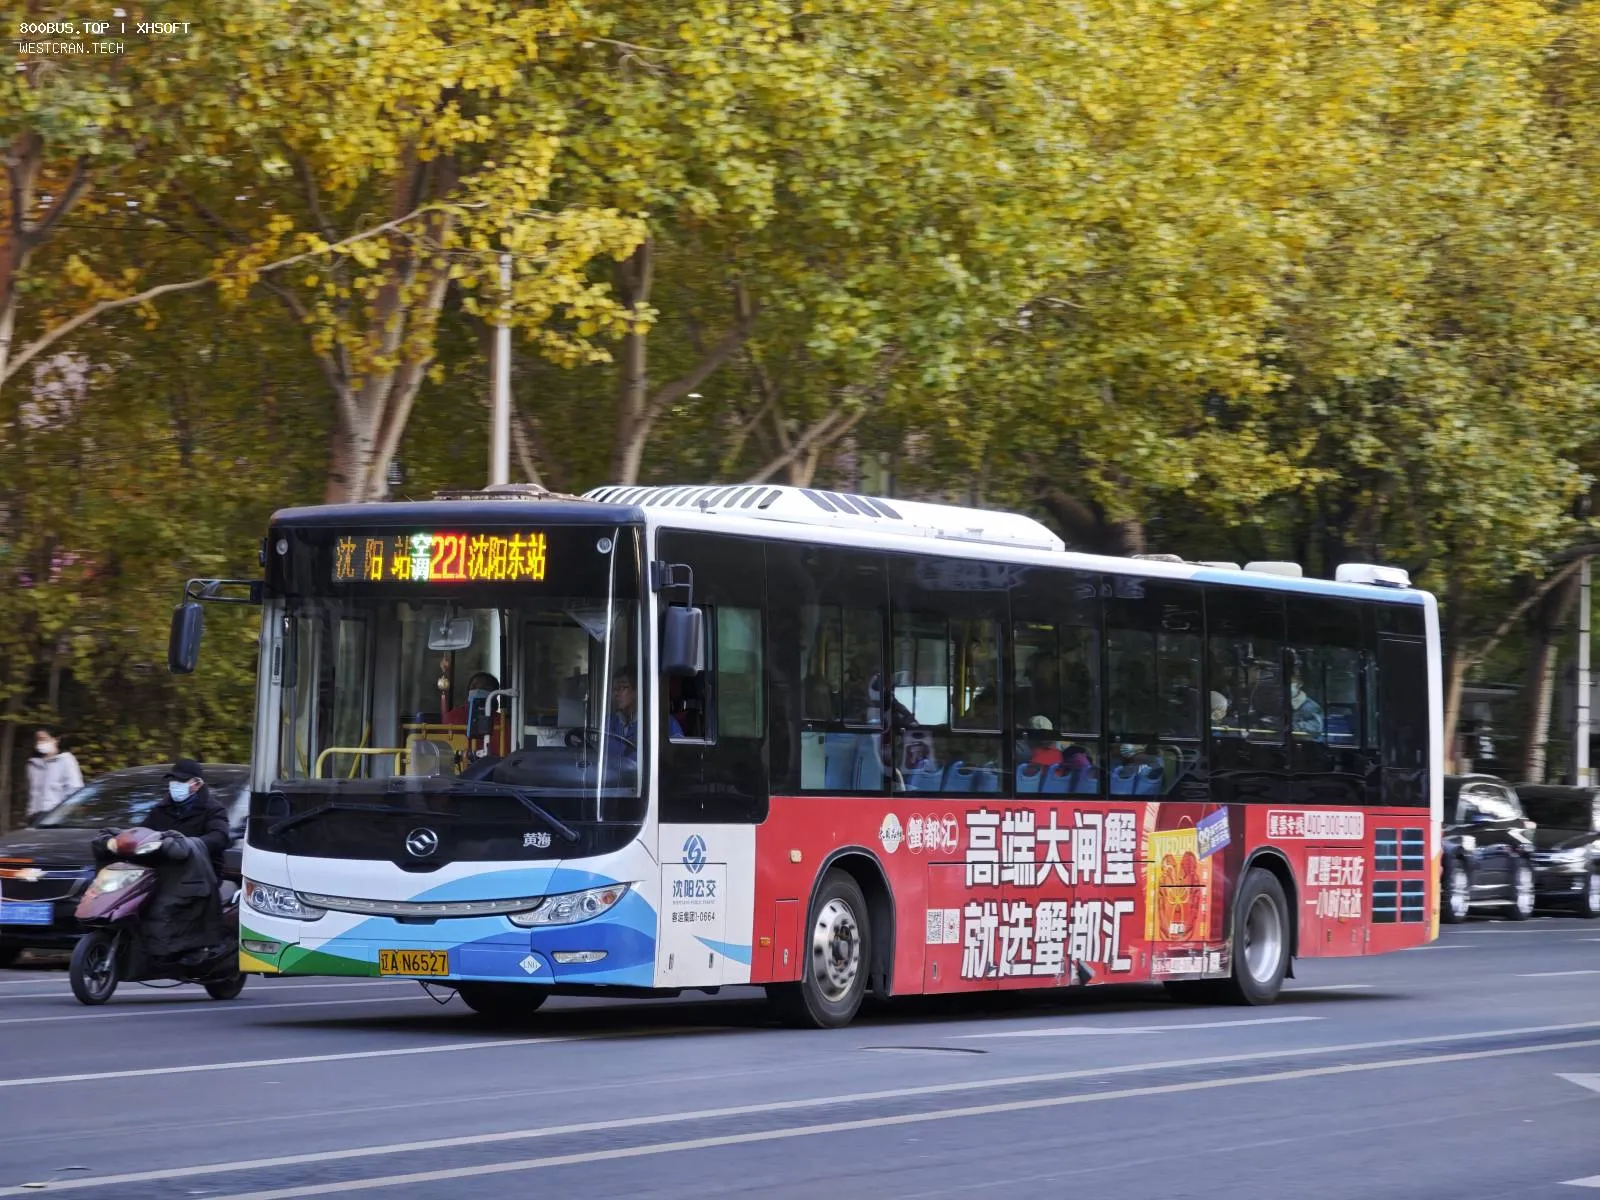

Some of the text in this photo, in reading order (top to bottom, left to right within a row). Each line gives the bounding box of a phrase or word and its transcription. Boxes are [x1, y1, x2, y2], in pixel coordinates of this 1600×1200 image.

[430, 535, 466, 580] 221
[468, 533, 546, 580] 沈阳东站
[523, 832, 551, 848] 黄海
[964, 808, 1137, 887] 高端大闸蟹
[672, 879, 717, 898] 沈阳公交
[960, 899, 1136, 979] 就选蟹都汇
